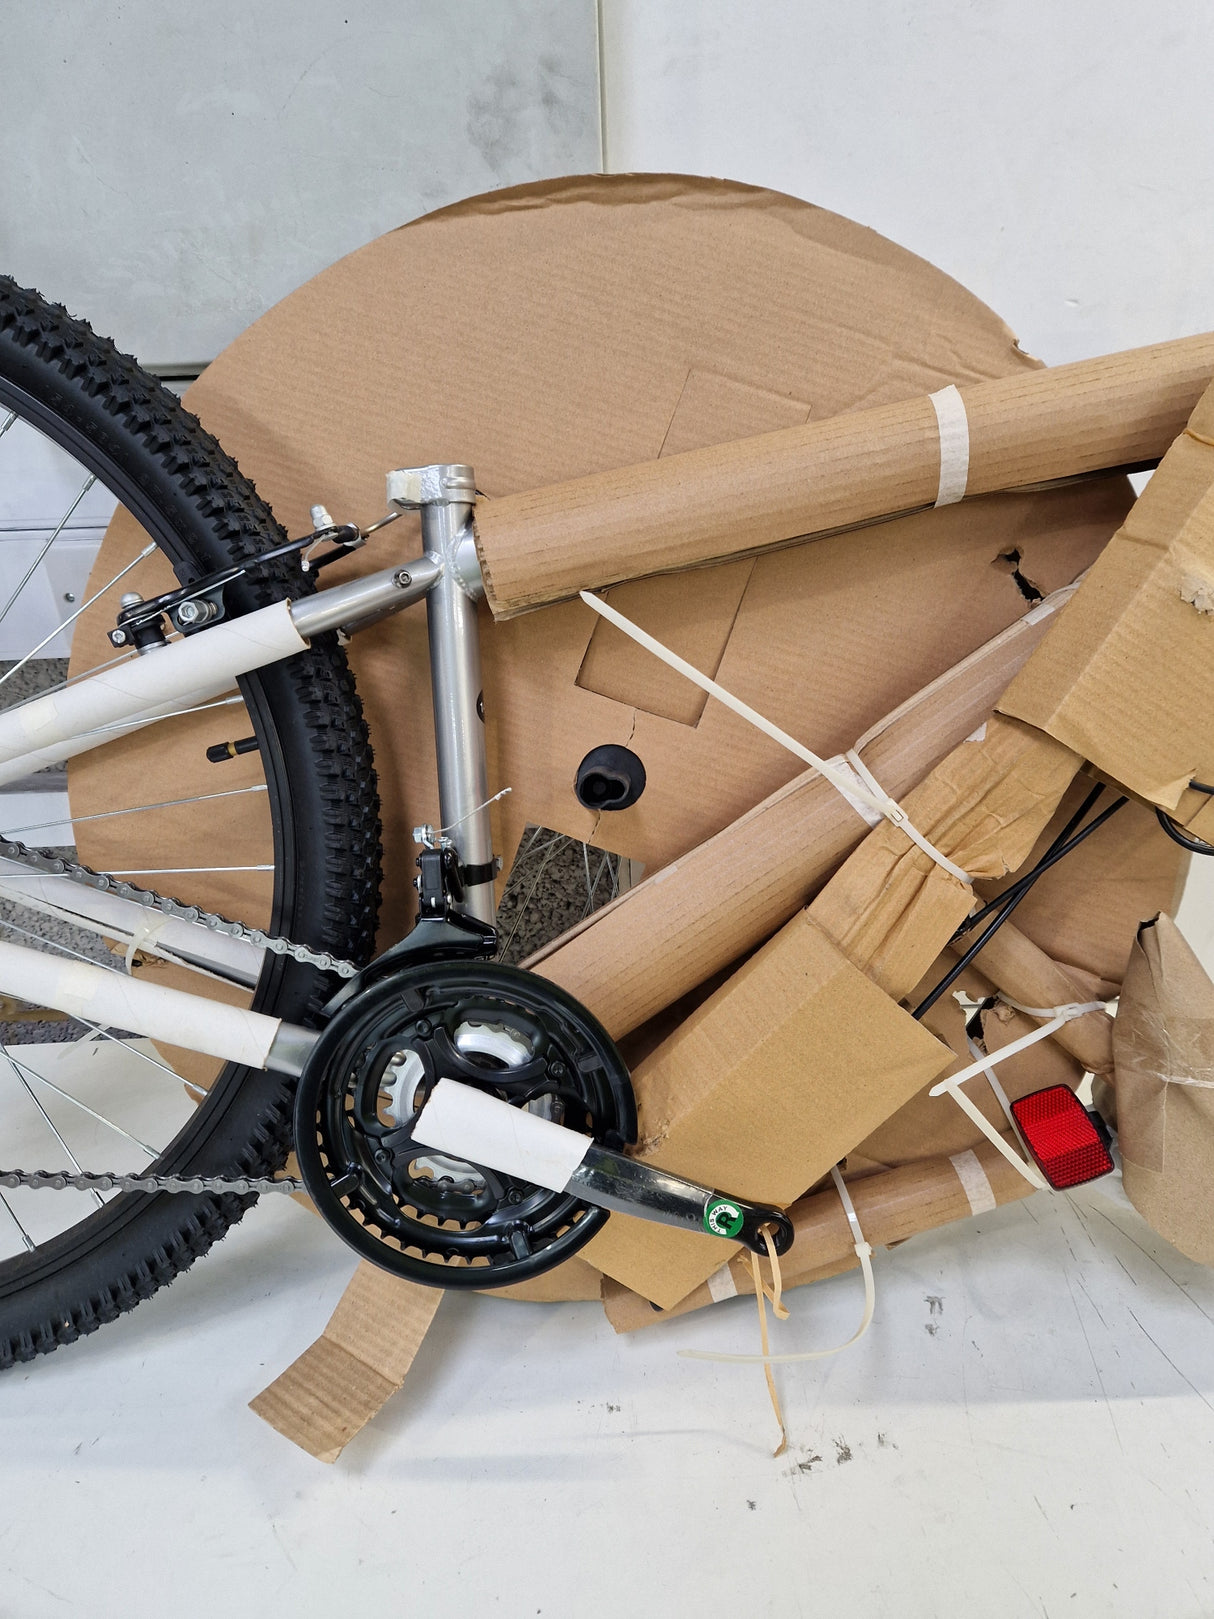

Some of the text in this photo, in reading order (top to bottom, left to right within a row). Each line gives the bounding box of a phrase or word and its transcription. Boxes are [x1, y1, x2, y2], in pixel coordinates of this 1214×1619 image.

[710, 1206, 728, 1232] THIS WAY
[716, 1213, 737, 1229] R
